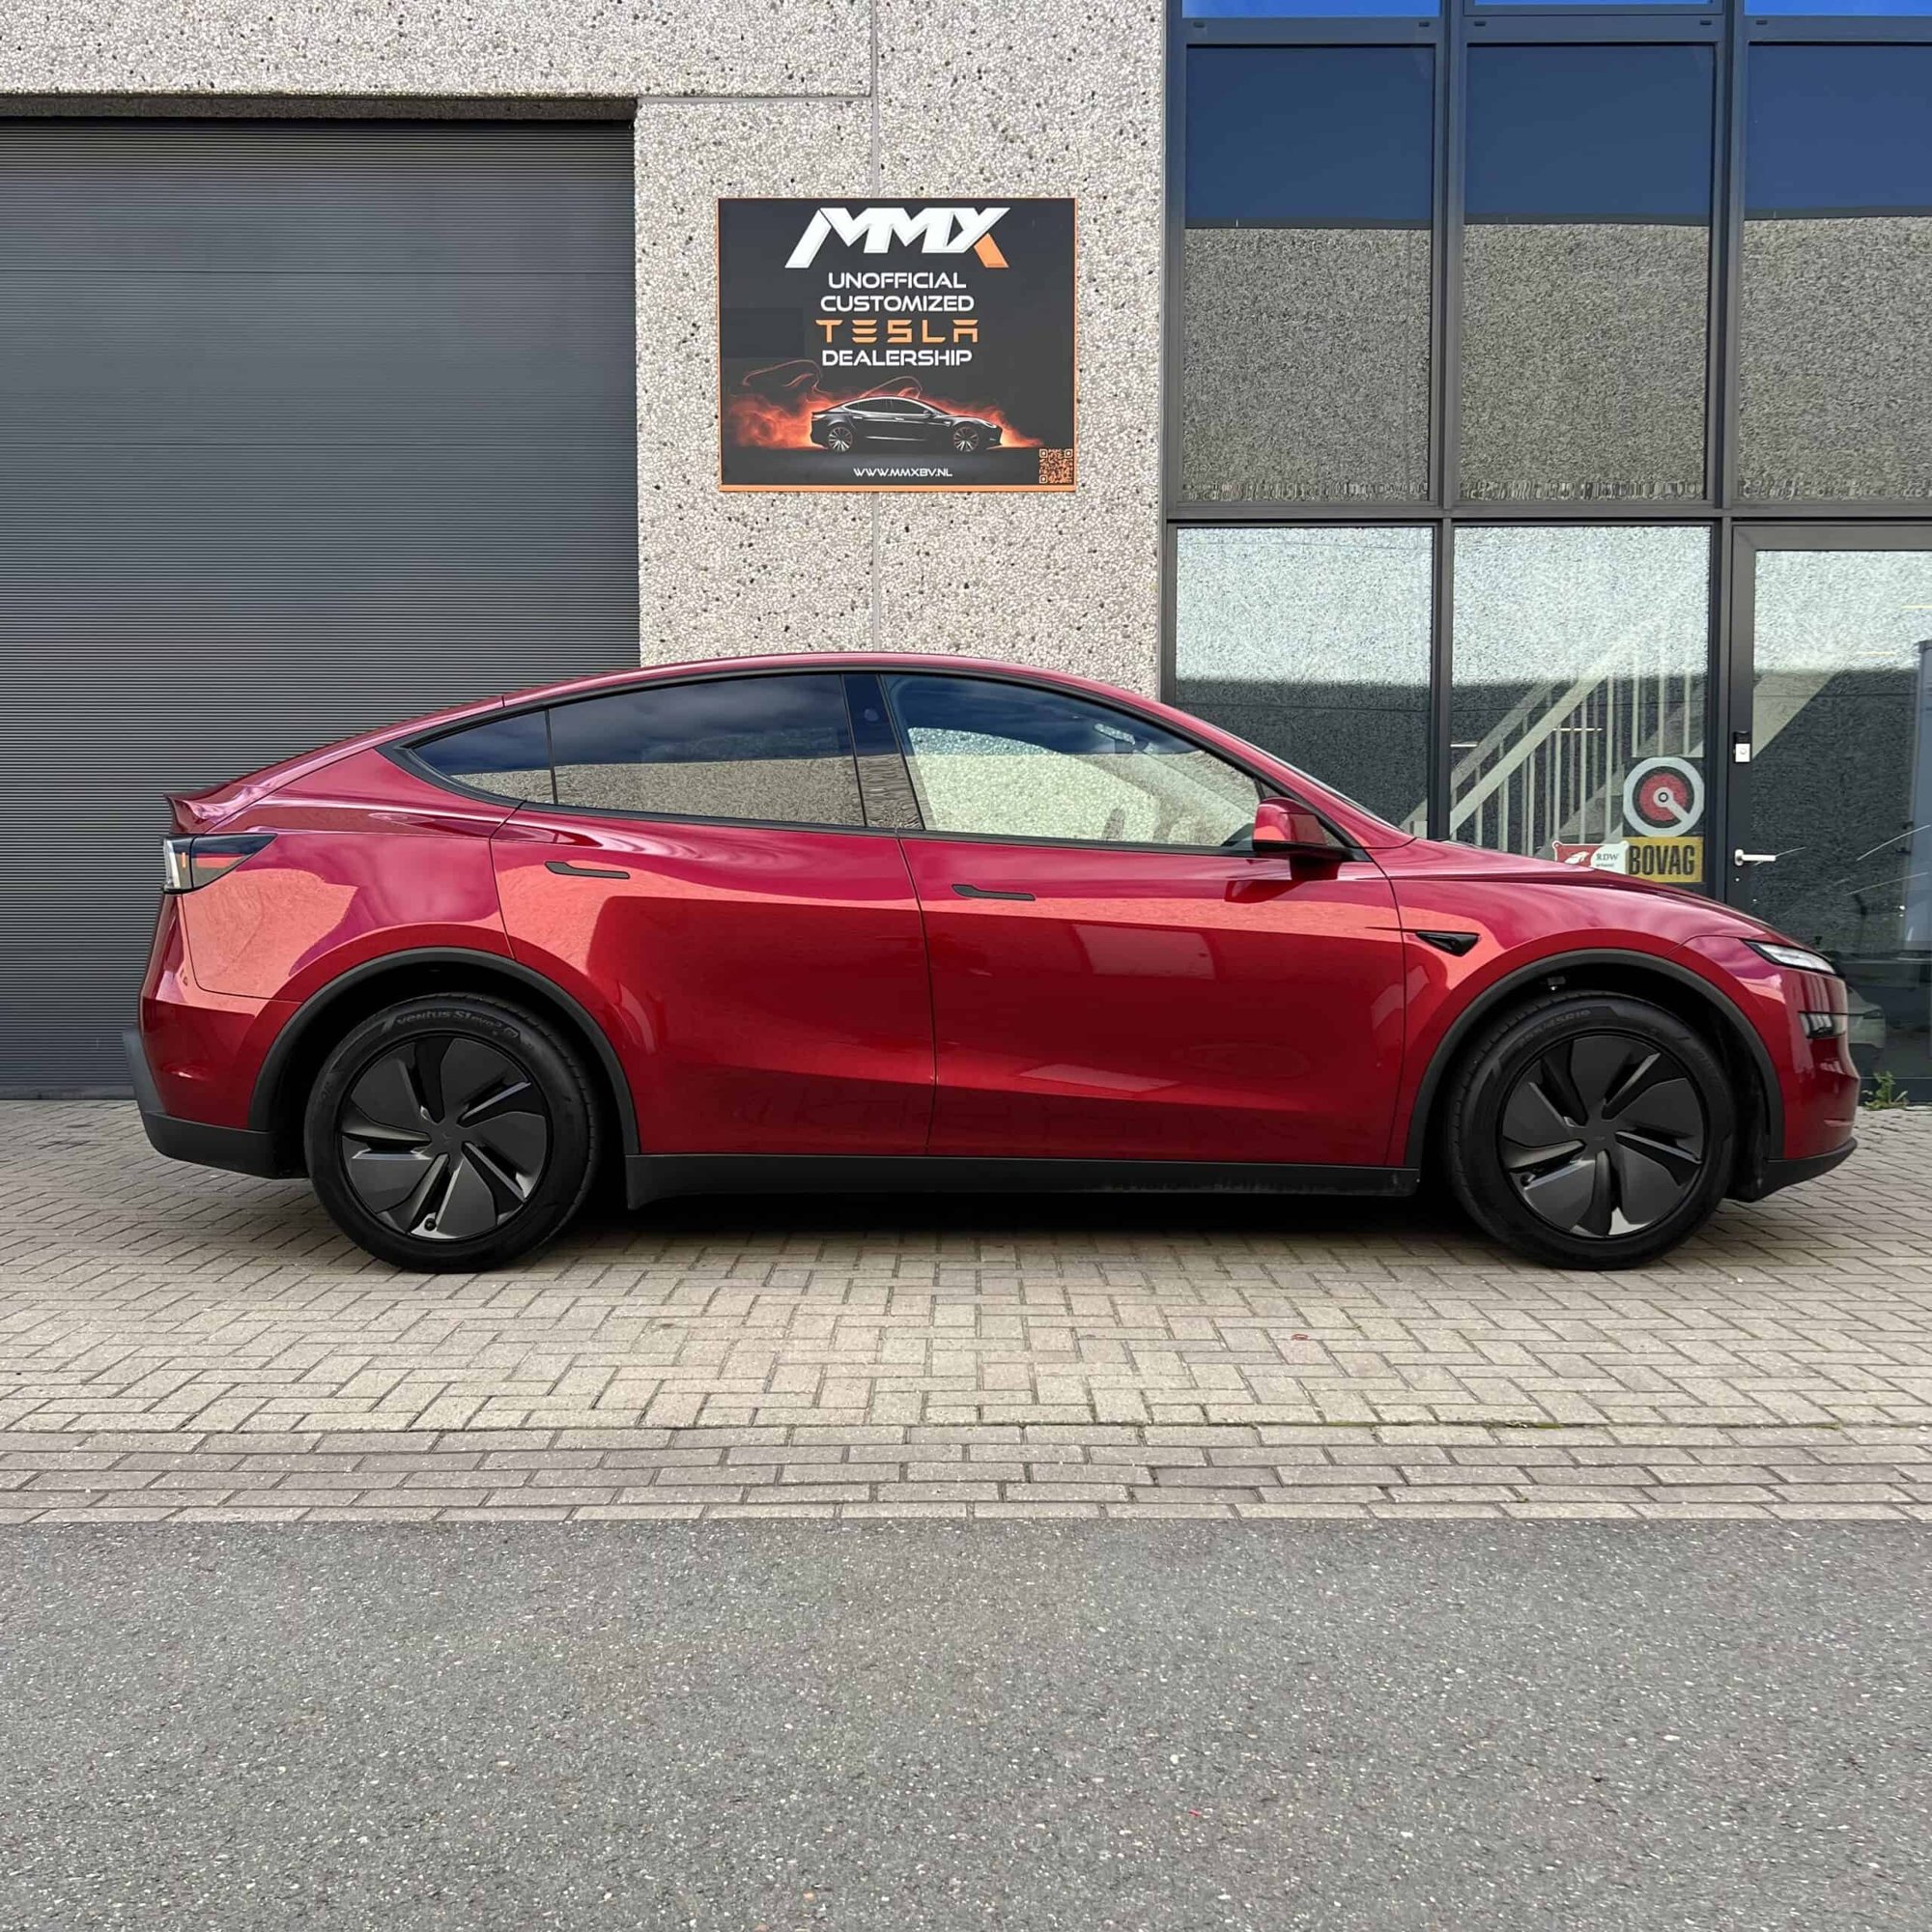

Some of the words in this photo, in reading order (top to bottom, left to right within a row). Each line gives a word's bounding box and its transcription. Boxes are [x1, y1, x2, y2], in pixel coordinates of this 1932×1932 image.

[784, 207, 1011, 269] MMX
[828, 271, 967, 290] UNOFFICIAL
[820, 295, 975, 313] CUSTOMIZED
[815, 319, 979, 344] TESLA
[821, 349, 973, 367] DEALERSHIP
[852, 467, 953, 478] WWW.MMXBV.NL
[1628, 844, 1695, 875] BOVAG
